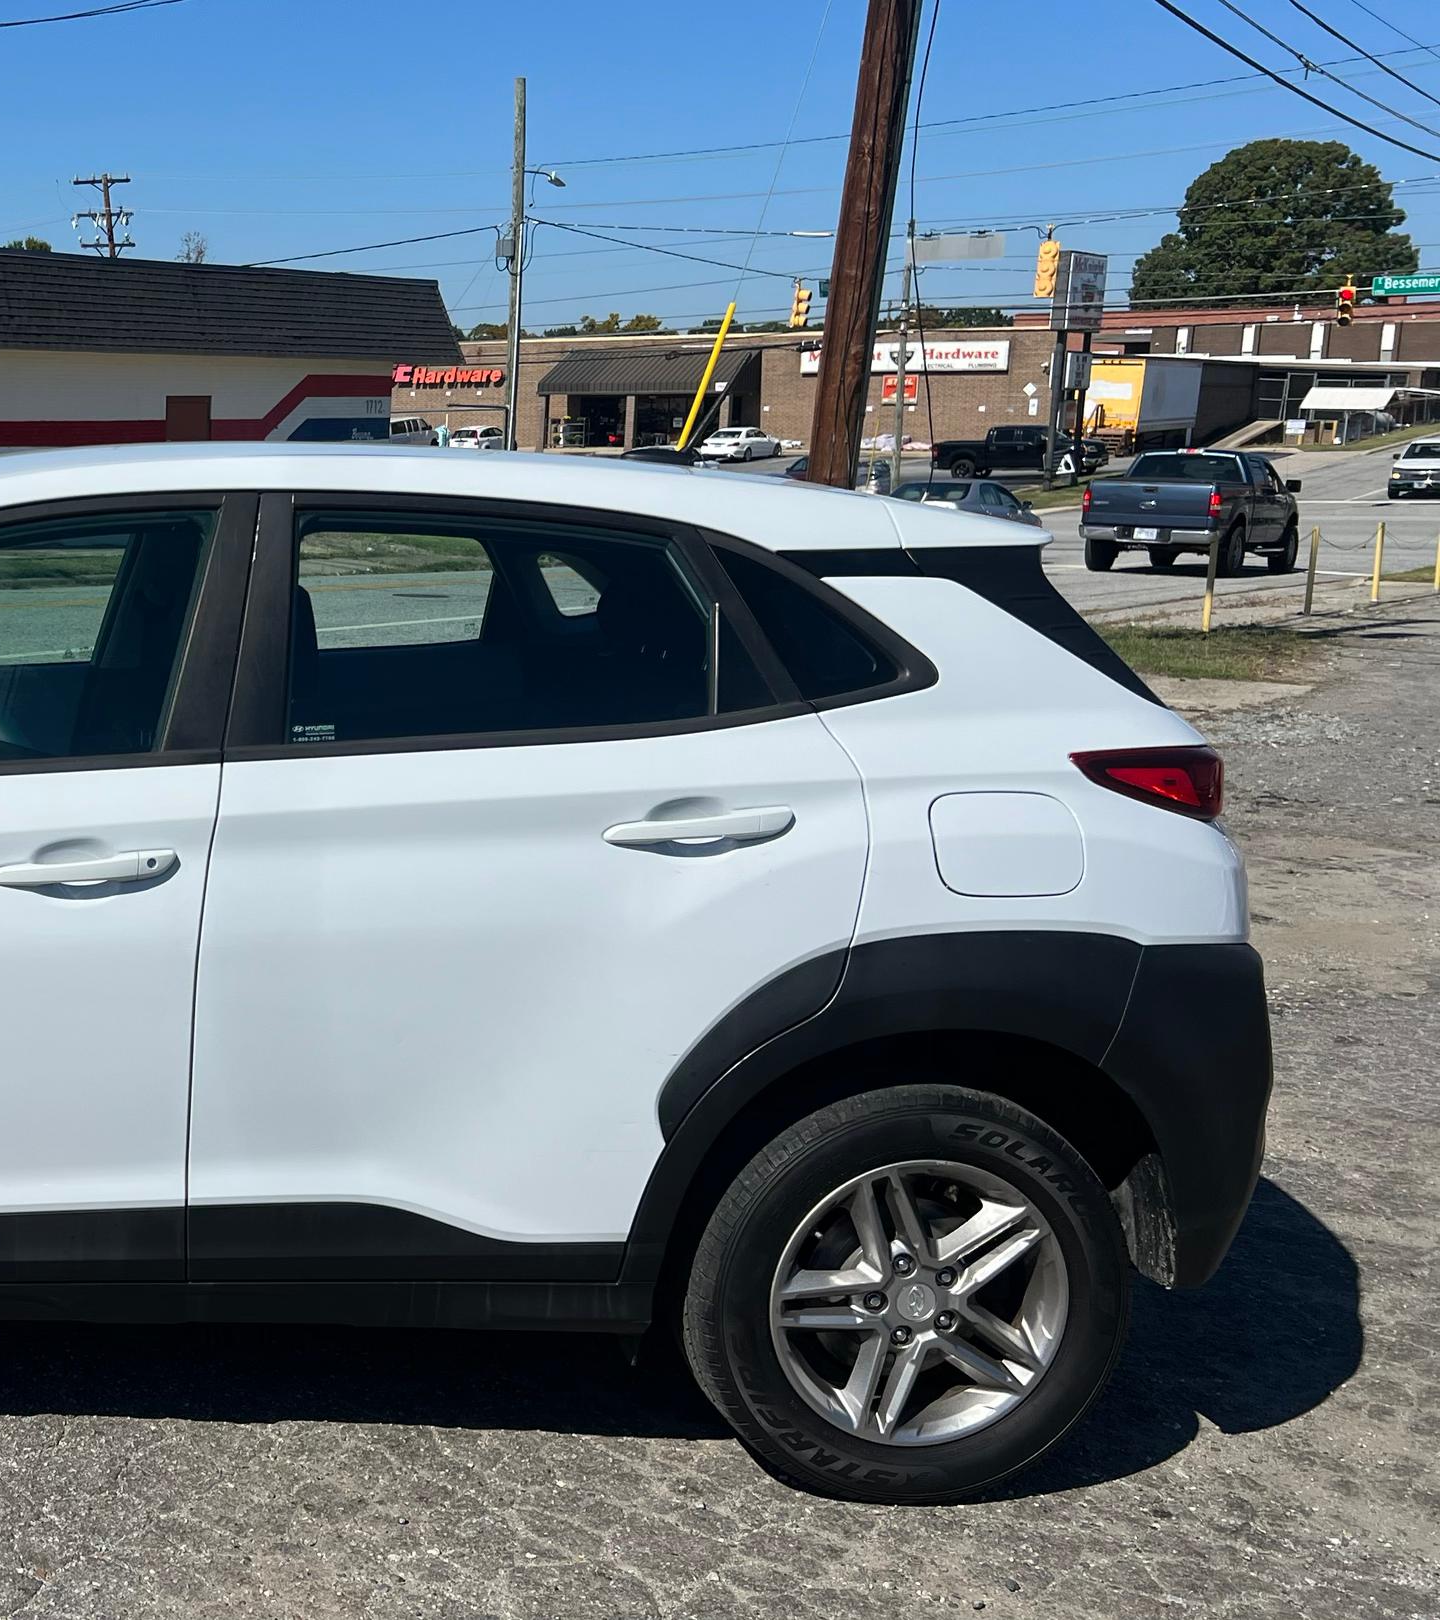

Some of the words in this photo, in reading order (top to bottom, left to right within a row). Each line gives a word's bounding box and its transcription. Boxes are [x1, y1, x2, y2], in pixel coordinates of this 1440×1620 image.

[1384, 277, 1440, 289] Bessemer
[923, 348, 999, 360] Hardware
[412, 366, 502, 384] Hardware
[366, 400, 383, 414] 1712
